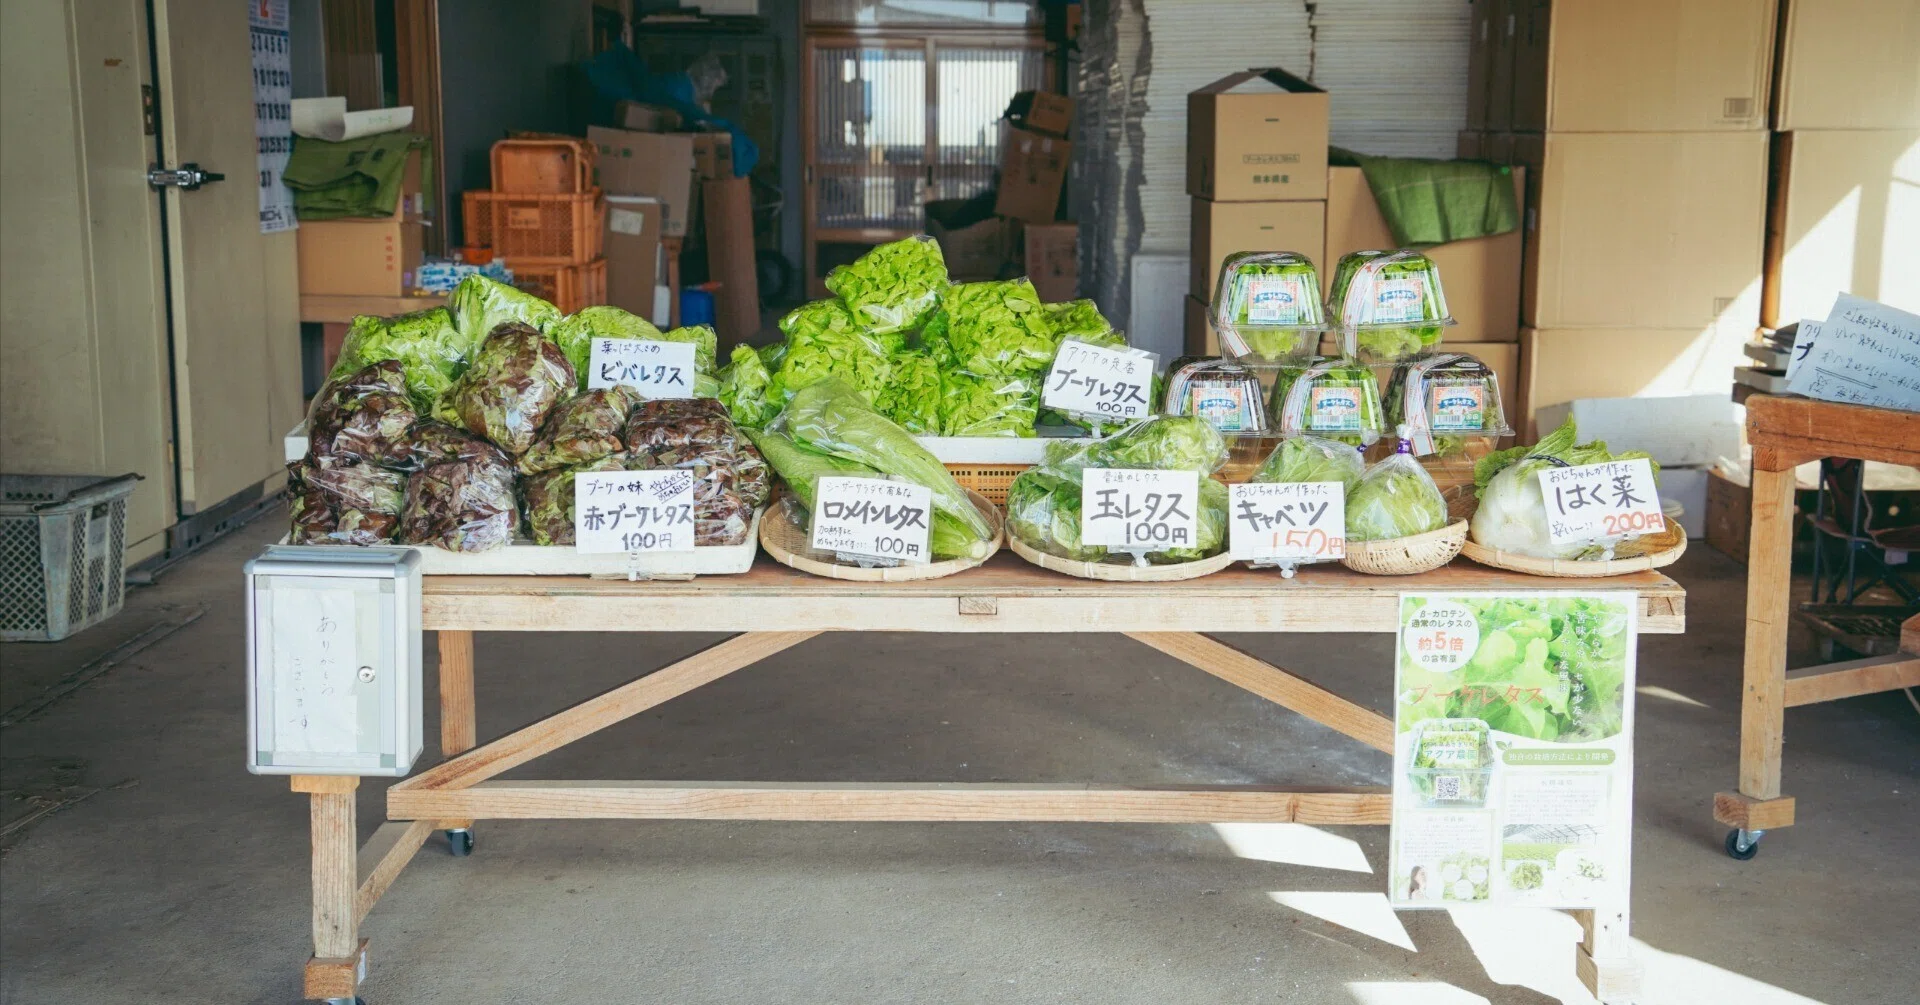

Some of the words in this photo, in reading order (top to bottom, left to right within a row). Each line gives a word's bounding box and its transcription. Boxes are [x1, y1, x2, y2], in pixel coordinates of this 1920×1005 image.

[600, 340, 661, 354] 葉っぱ大きめ
[1066, 346, 1136, 375] アクアの定番
[600, 360, 685, 386] ビバレタス
[1053, 368, 1147, 405] ブーケレタス
[1095, 401, 1137, 416] 100円
[1102, 472, 1160, 484] 普通のレタス
[1549, 463, 1635, 483] おじちゃんが作った
[586, 478, 644, 496] ブーケの妹
[826, 480, 912, 498] シーザーサラダで有名な
[1236, 483, 1329, 497] おじちゃんが作った
[1555, 475, 1647, 515] はく菜
[823, 500, 927, 531] ロメインレタス
[1090, 488, 1191, 522] 玉レタス
[584, 502, 693, 531] 赤ブーケレタス
[1236, 500, 1329, 532] キャベツ
[1602, 511, 1663, 536] 200円
[620, 532, 673, 551] 100円
[1125, 522, 1188, 544] 100円
[1270, 528, 1345, 556] 150円
[875, 536, 920, 557] 100円
[1411, 619, 1473, 629] 通常のレタスの
[1417, 631, 1465, 652] 約5倍
[1591, 613, 1602, 670] やわらかく
[315, 616, 338, 697] ありがとう
[1421, 654, 1458, 664] の含有量
[1424, 749, 1478, 760] アクア農園
